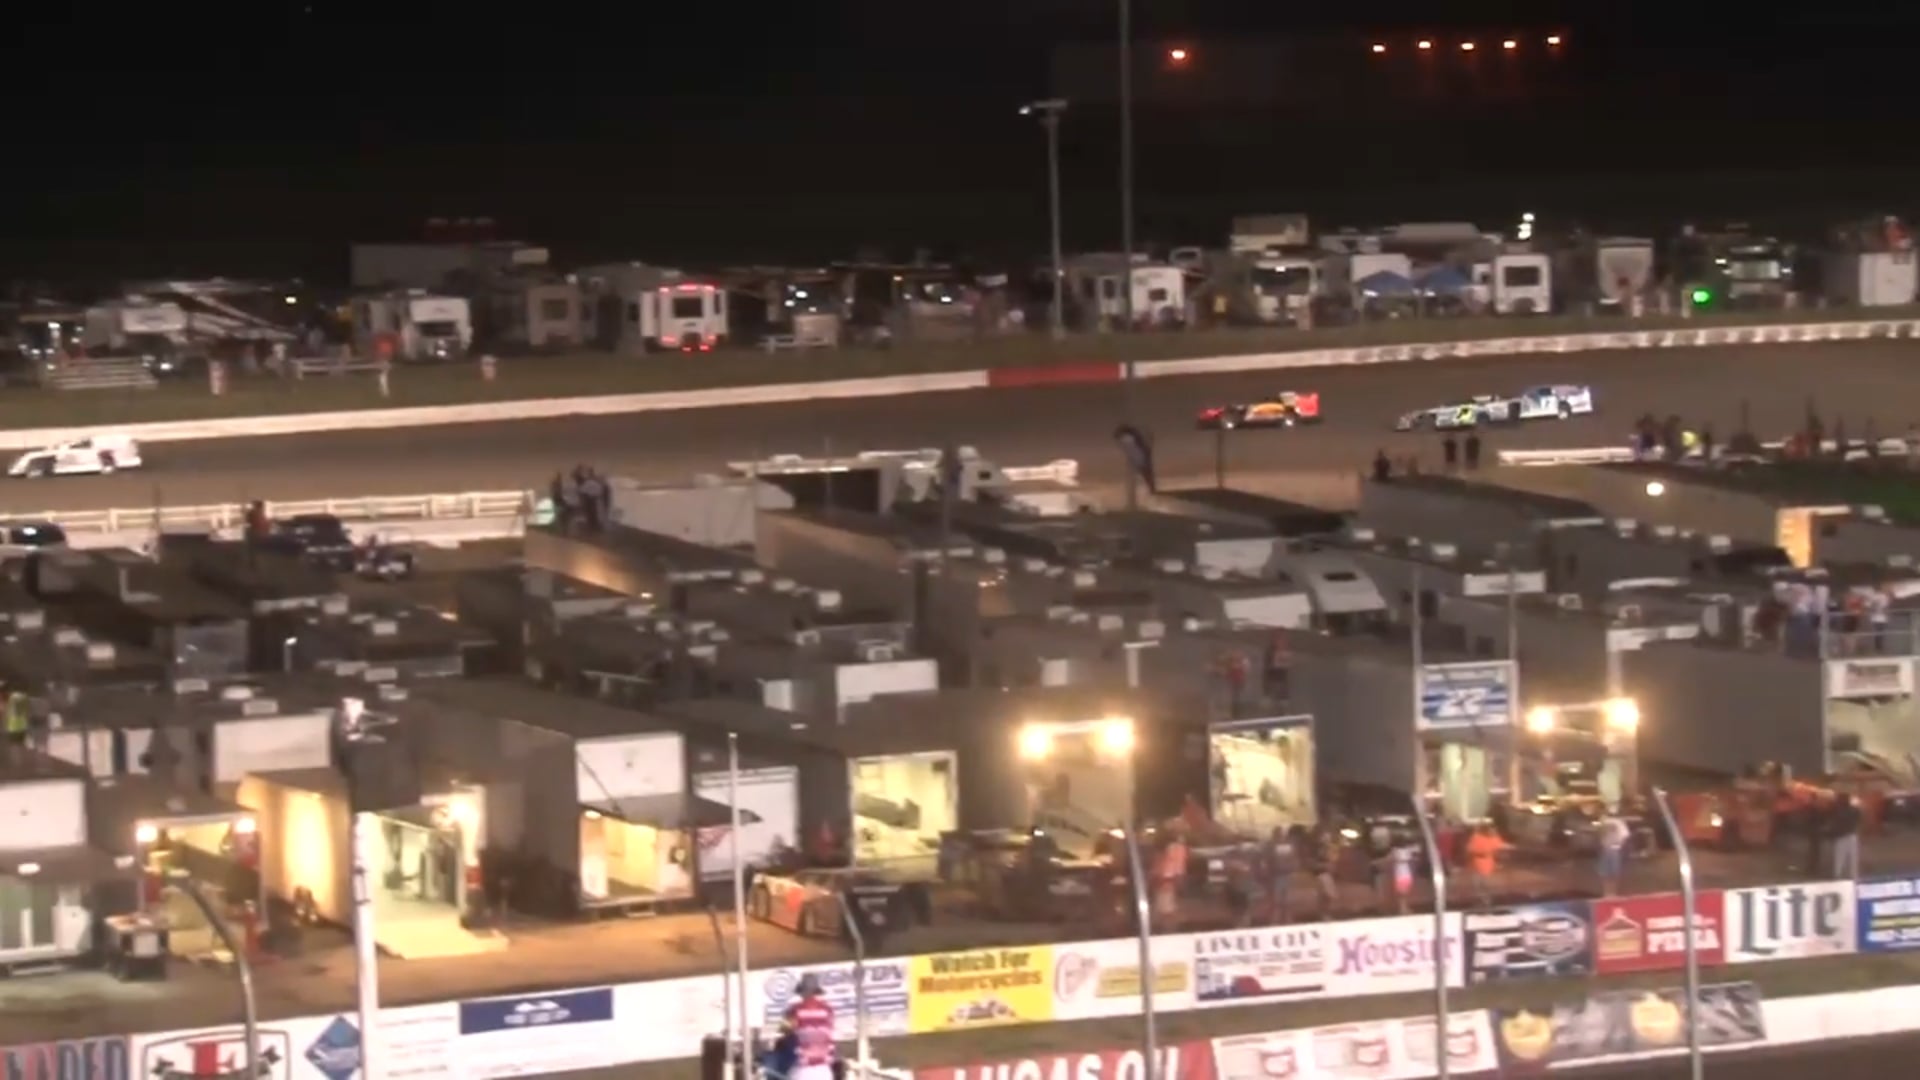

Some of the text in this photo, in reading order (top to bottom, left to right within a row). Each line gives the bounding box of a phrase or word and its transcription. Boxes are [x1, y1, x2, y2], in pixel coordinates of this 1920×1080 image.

[1737, 888, 1842, 955] Lite
[930, 950, 1031, 974] Watch For
[1333, 930, 1456, 974] Hoosir
[919, 970, 1042, 994] Motorcycles
